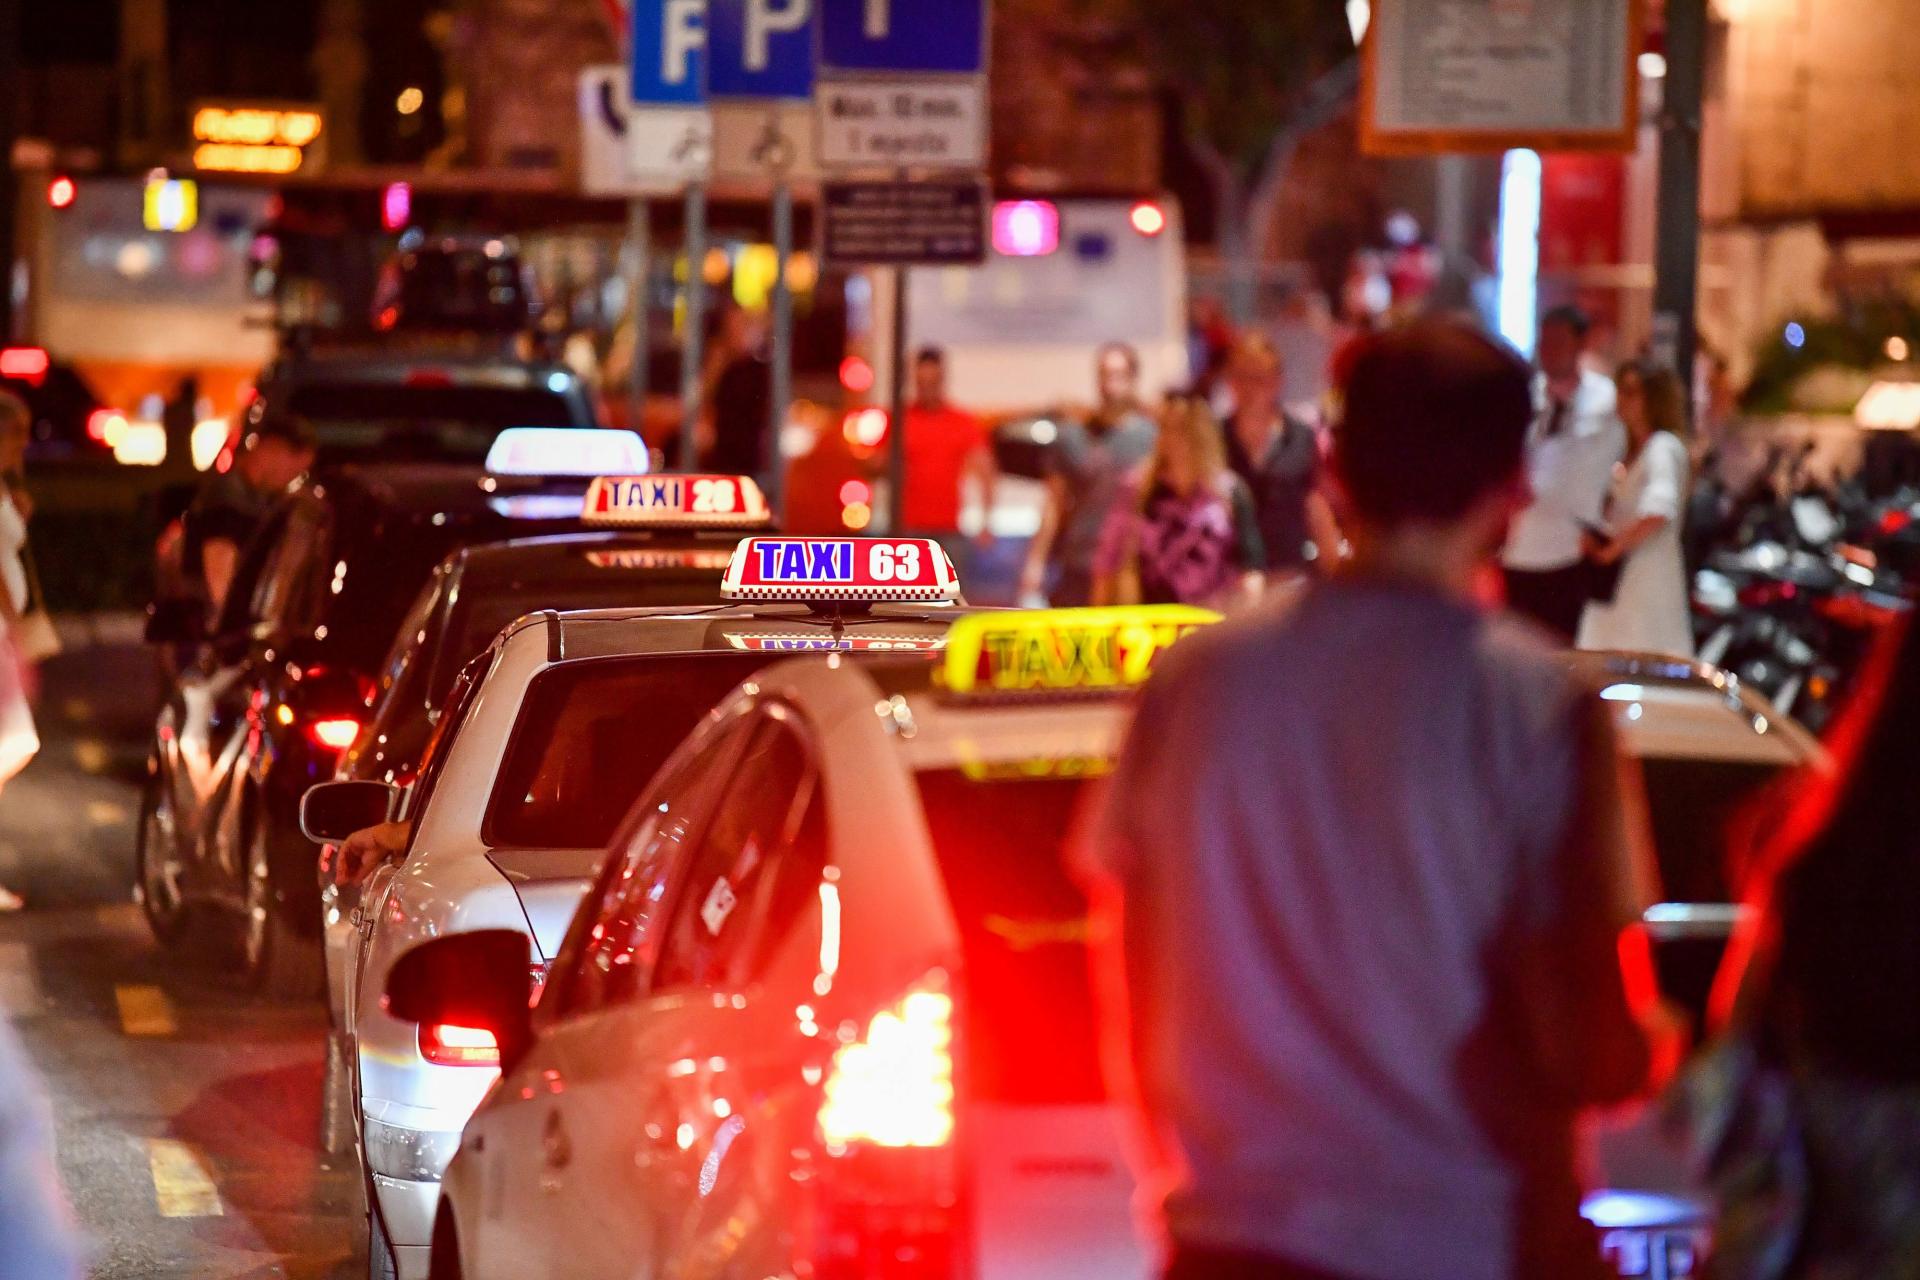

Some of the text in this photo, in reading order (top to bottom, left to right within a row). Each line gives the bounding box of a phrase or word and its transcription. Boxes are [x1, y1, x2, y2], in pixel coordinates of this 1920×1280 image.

[606, 480, 682, 510] TAXI
[754, 541, 921, 582] TAXI 63
[986, 629, 1118, 687] TAXI
